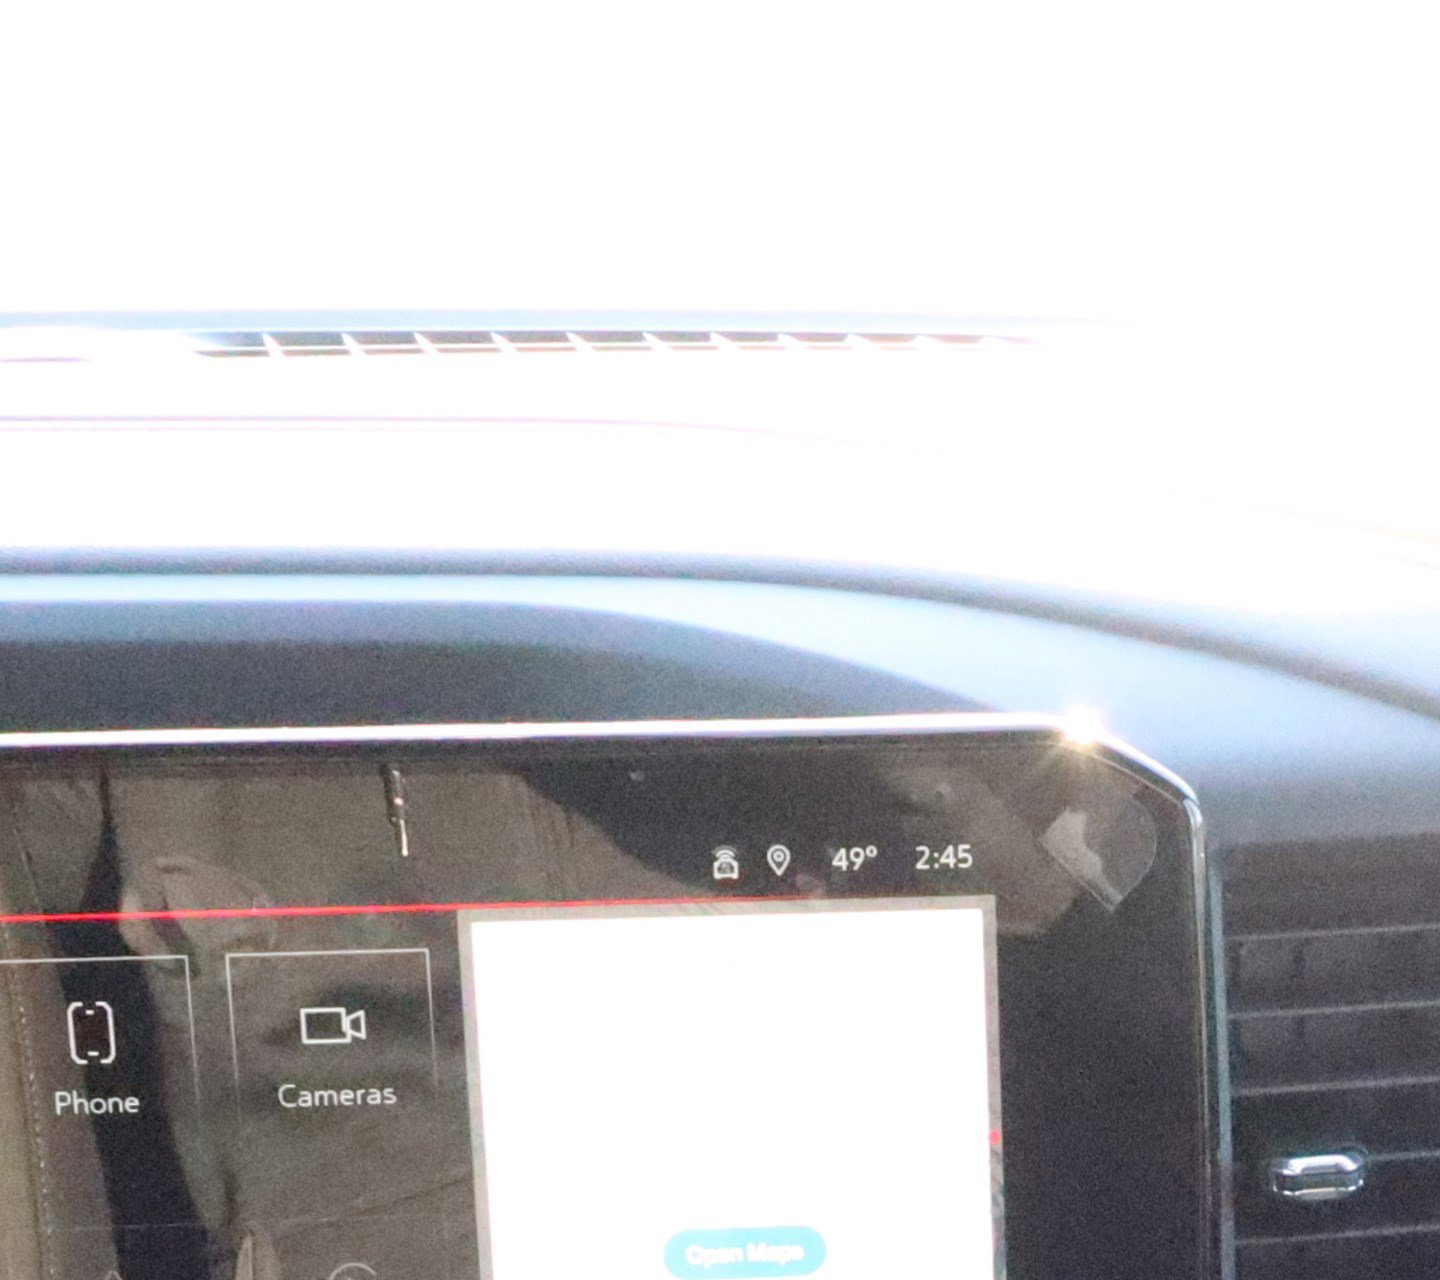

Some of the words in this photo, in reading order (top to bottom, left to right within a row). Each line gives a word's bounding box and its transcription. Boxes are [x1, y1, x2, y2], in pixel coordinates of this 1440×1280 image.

[914, 844, 974, 871] 2:45
[54, 1091, 141, 1116] Phone
[278, 1082, 397, 1109] Cameras
[685, 1245, 744, 1268] Open
[746, 1242, 804, 1265] Maps
